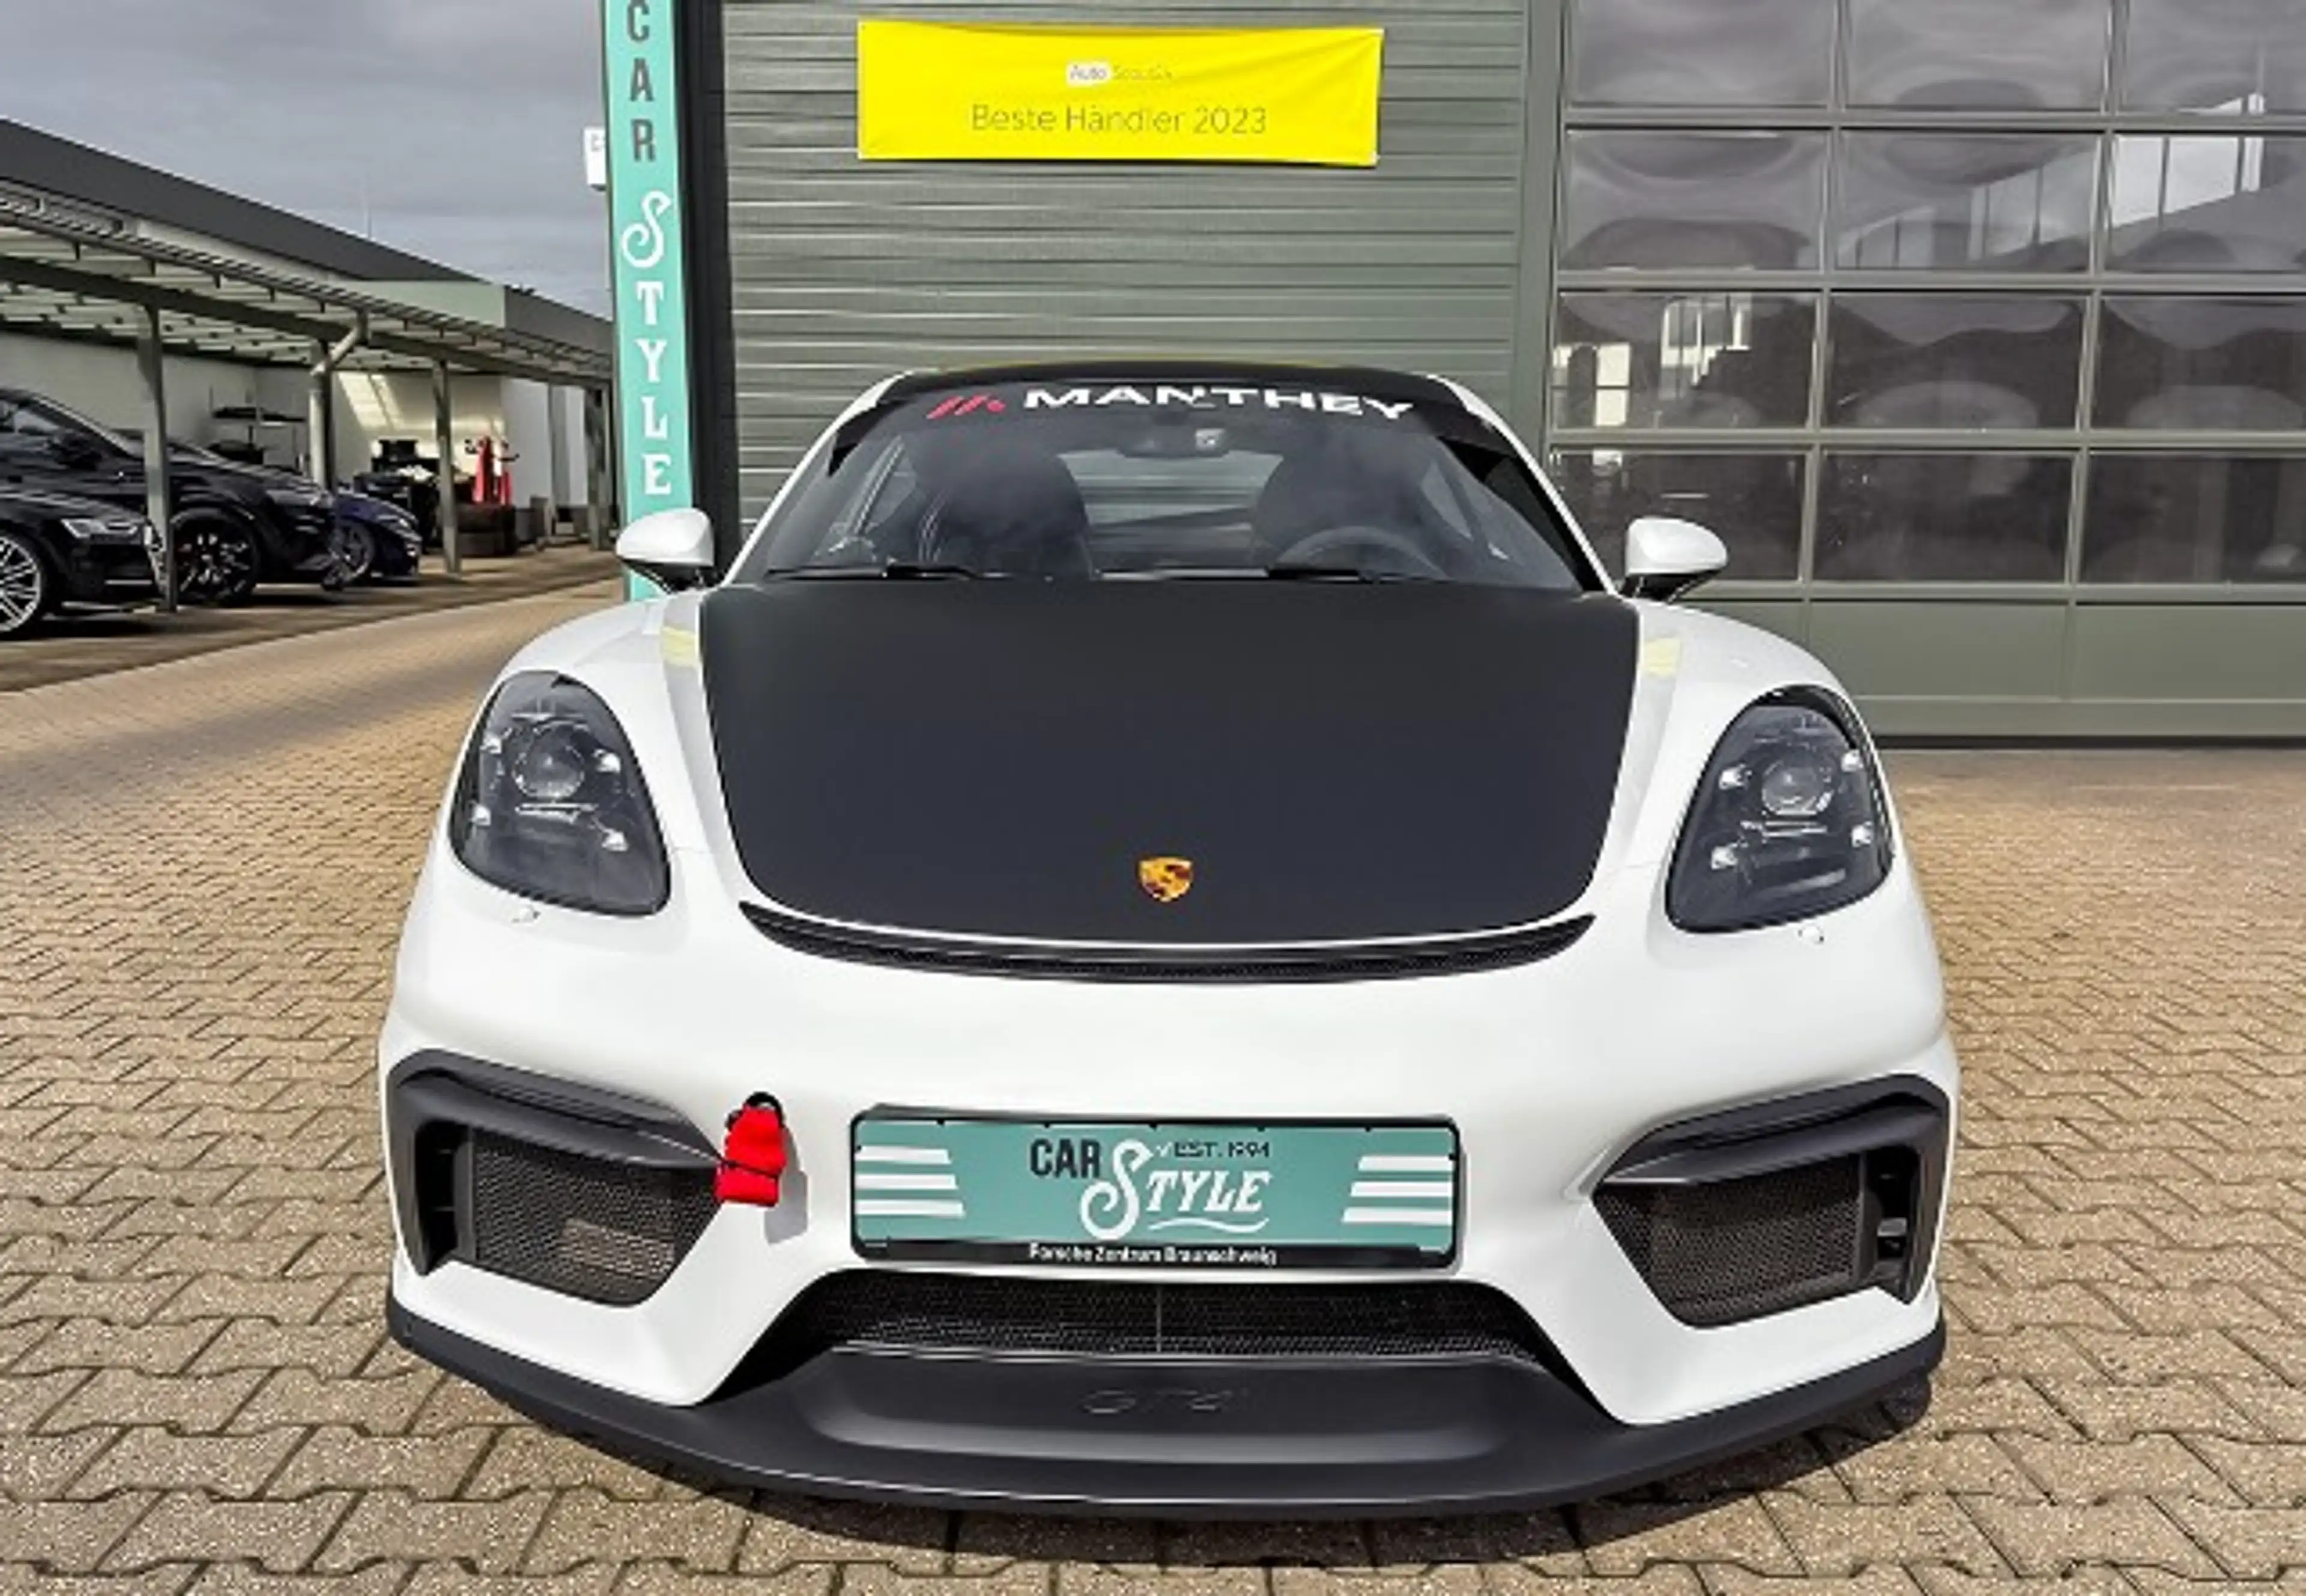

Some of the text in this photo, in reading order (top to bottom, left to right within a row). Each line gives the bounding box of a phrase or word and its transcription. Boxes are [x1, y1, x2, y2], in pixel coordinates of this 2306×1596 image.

[1070, 63, 1107, 80] Auto
[971, 103, 1266, 135] Beste Händler 2023
[621, 0, 671, 496] CAR STYLE
[1023, 385, 1414, 419] MANTHEY
[1174, 1141, 1270, 1158] EST. 1994
[1029, 1138, 1273, 1241] CAR STYLE
[1095, 1245, 1161, 1262] Zentrum
[1164, 1245, 1278, 1266] Braunschweig
